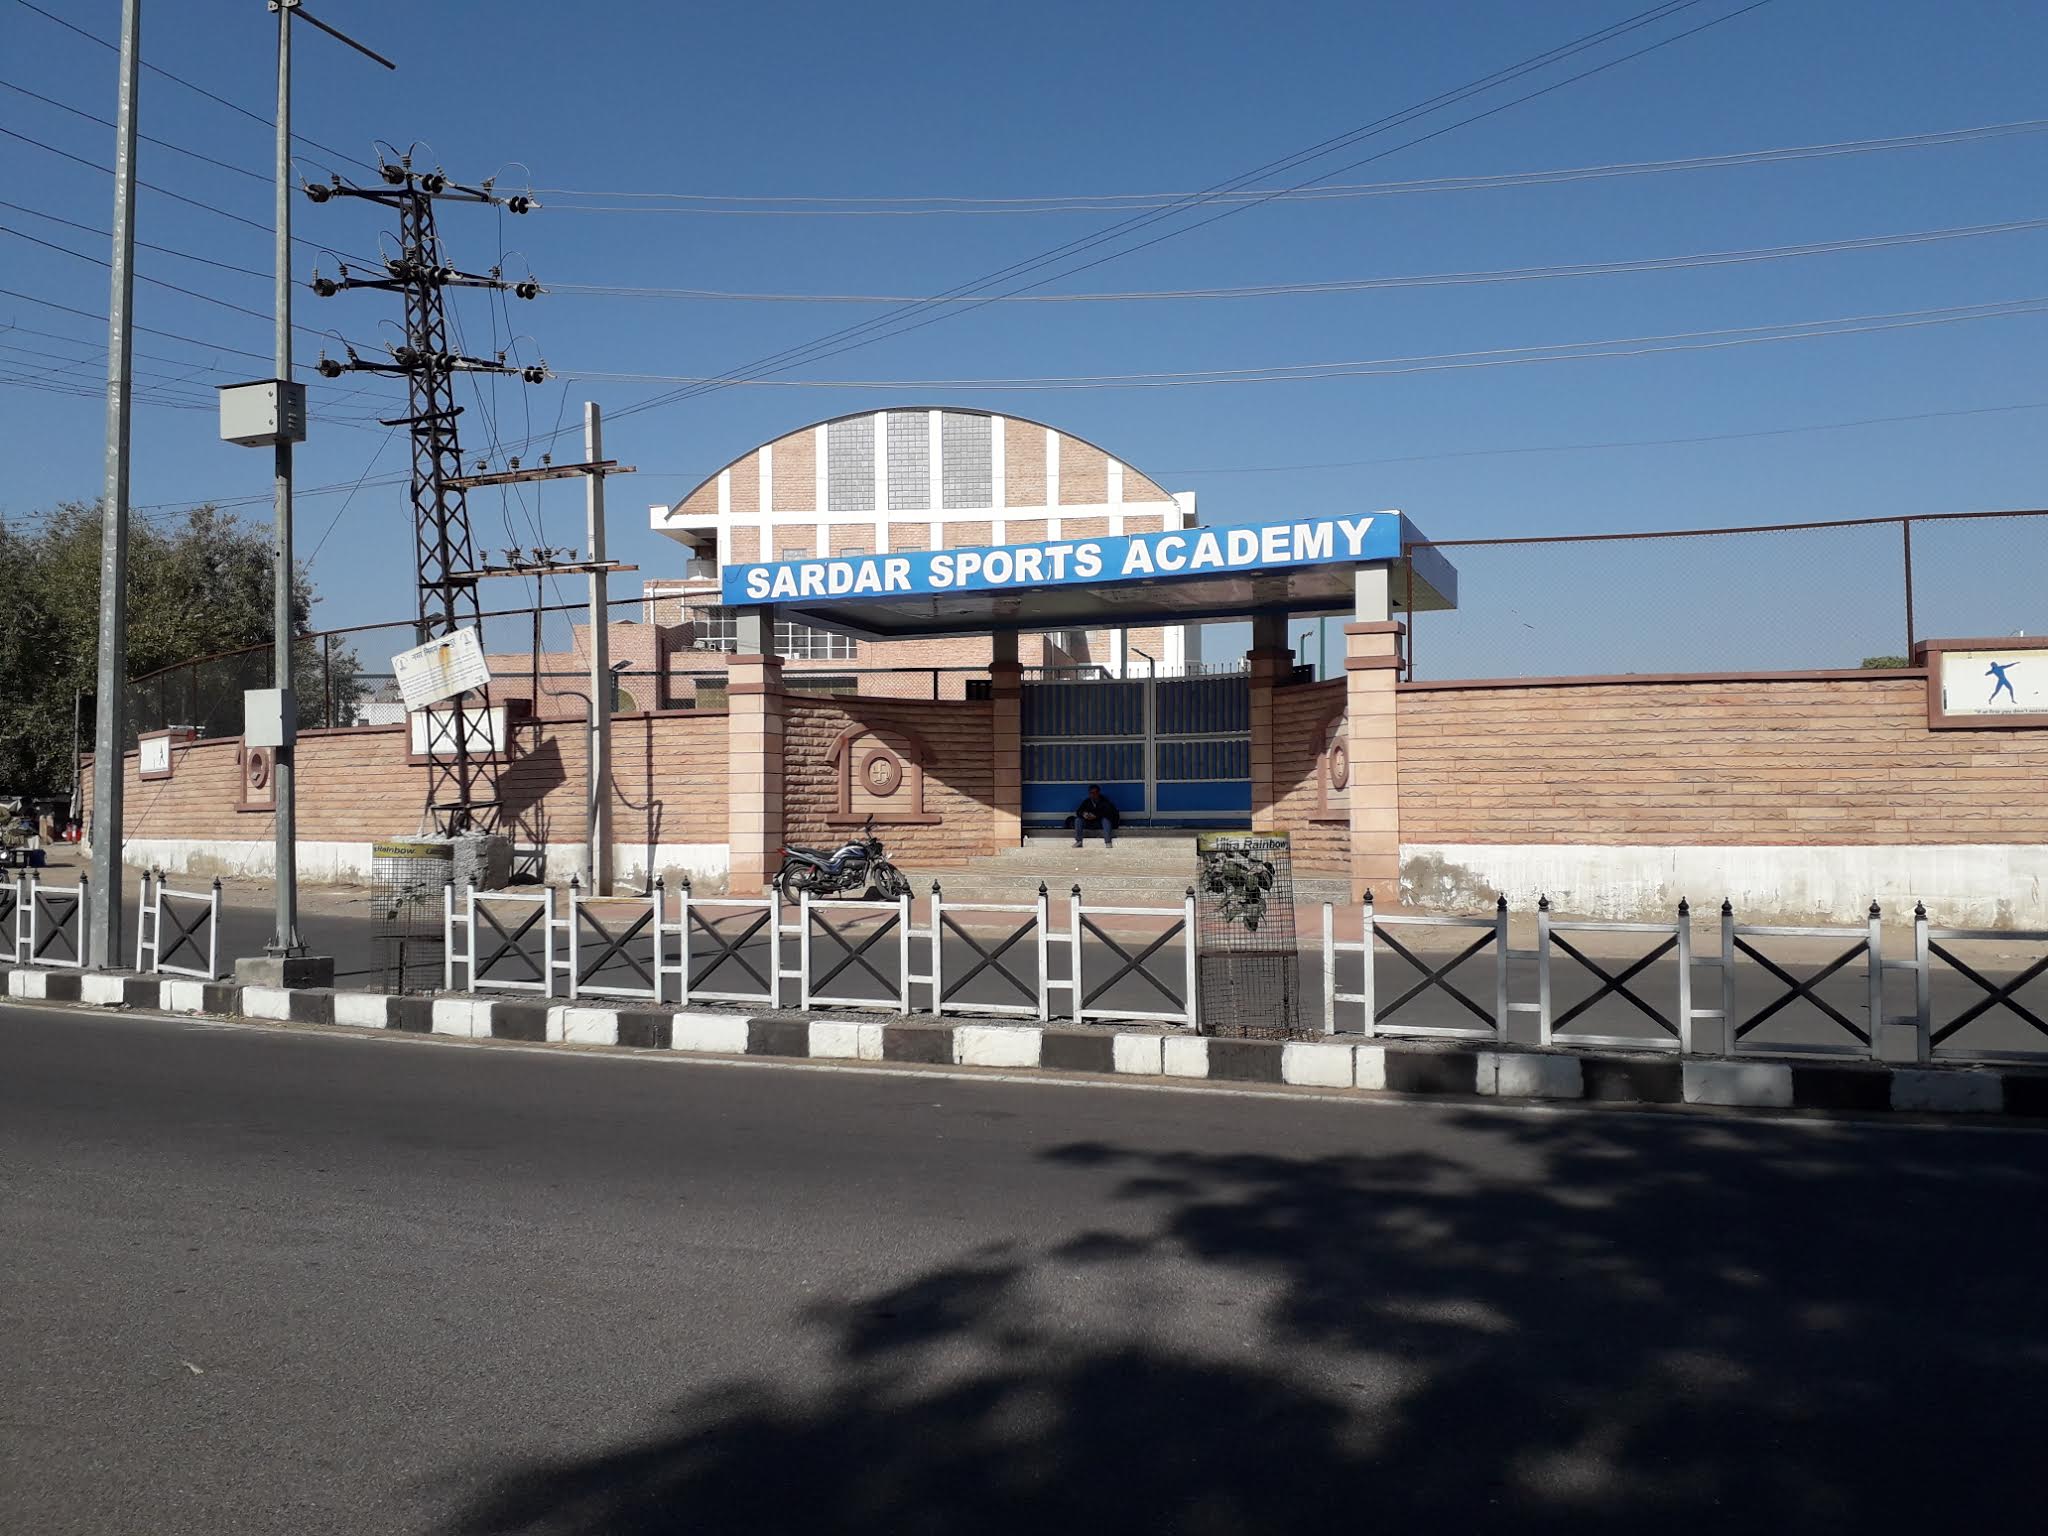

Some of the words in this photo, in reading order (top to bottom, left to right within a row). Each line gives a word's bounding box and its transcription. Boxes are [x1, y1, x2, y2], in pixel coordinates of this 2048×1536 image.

[746, 557, 912, 599] SARDAR
[928, 543, 1102, 588] SPORTS
[1121, 517, 1375, 576] ACADEMY
